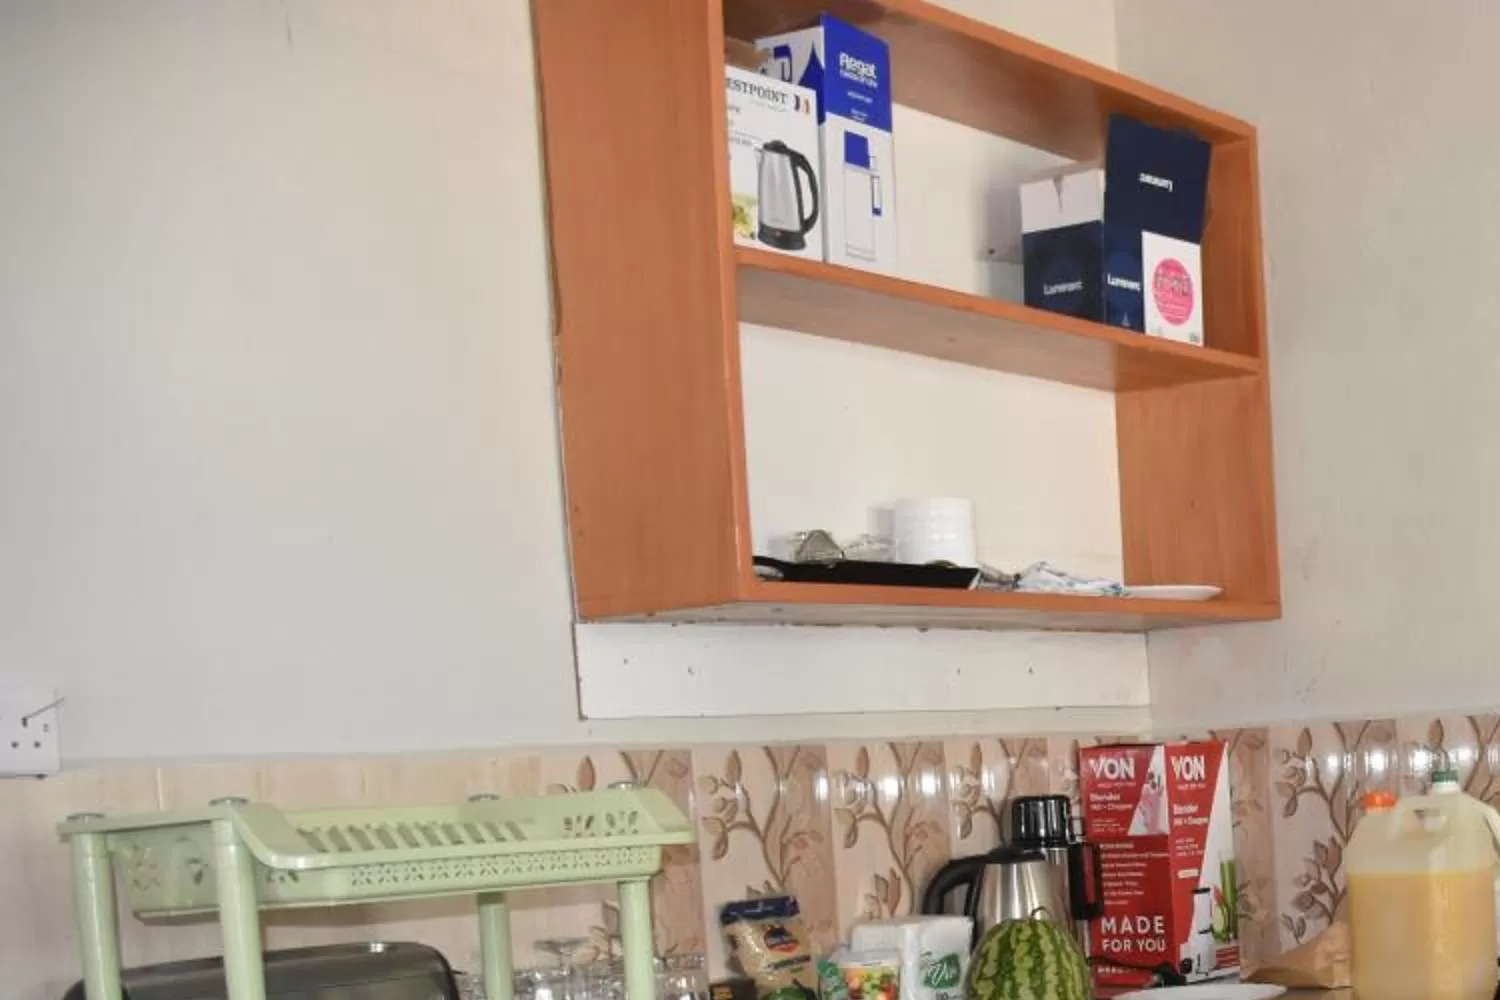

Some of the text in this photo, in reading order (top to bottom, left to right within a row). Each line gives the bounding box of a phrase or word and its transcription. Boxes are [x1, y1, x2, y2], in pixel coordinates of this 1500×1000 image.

[725, 77, 788, 104] ESTPOINT
[1088, 756, 1136, 779] VON
[1170, 755, 1205, 780] VON
[1101, 915, 1165, 935] MADE
[1103, 938, 1166, 953] FOR YOU
